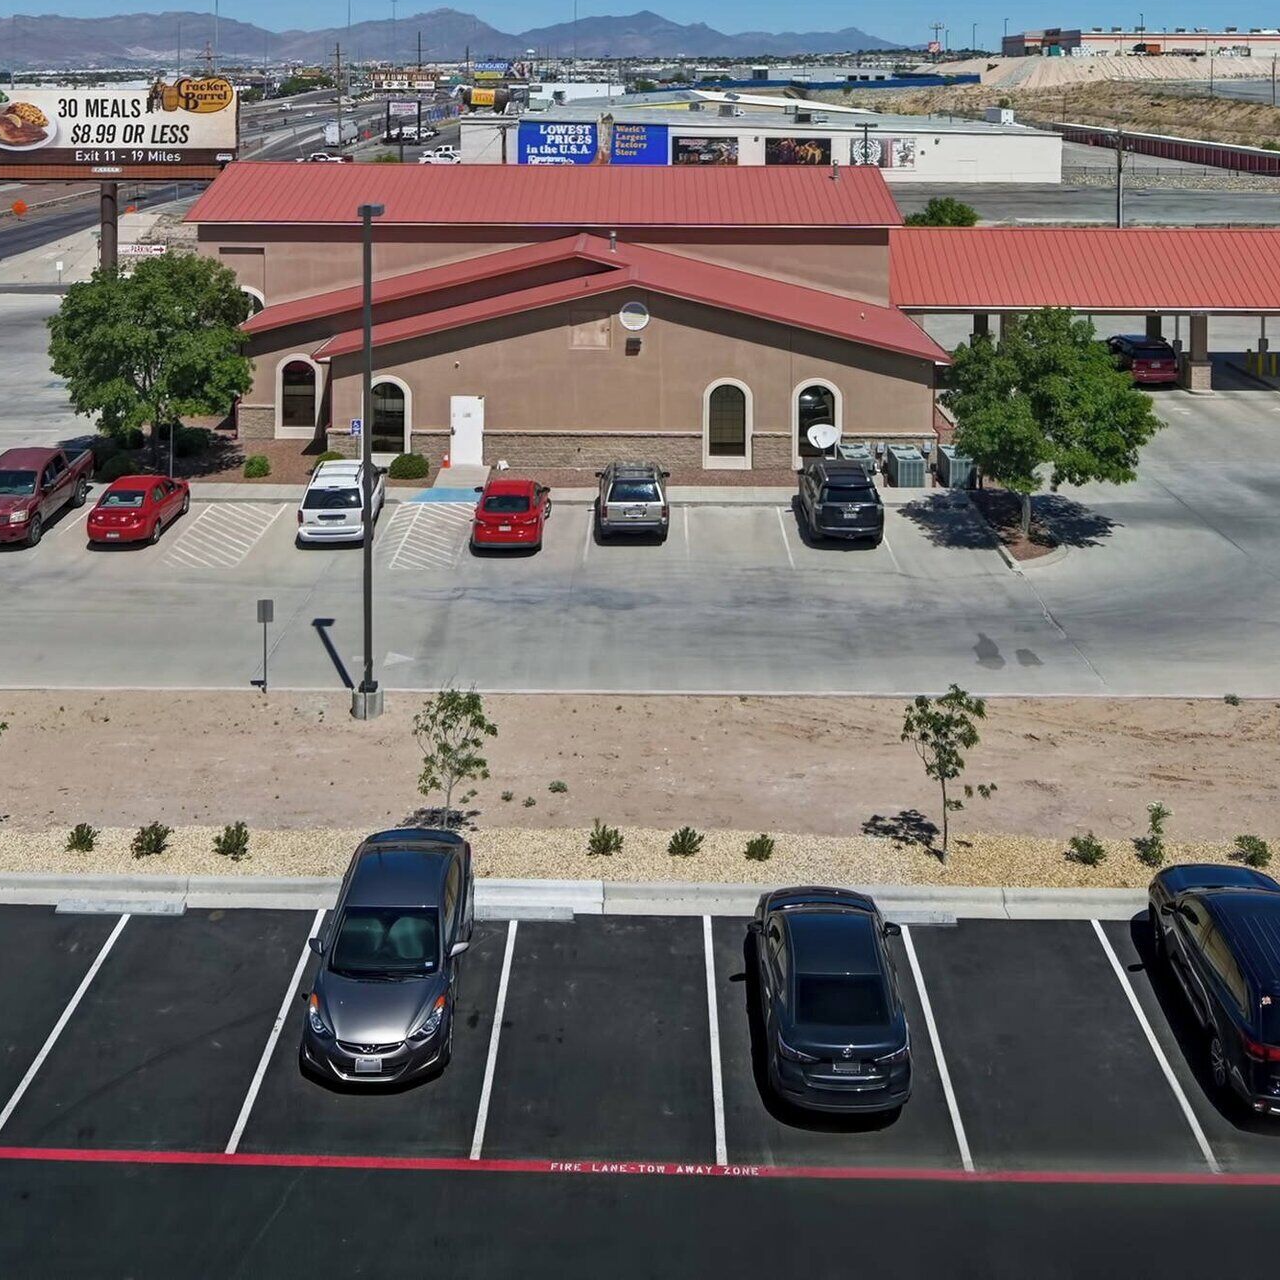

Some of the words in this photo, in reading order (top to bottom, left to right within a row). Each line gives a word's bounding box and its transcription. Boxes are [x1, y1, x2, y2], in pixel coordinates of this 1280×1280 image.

[177, 78, 228, 98] Cracker
[185, 91, 228, 111] Barrel
[58, 98, 78, 118] 30
[85, 98, 141, 118] MEALS
[70, 124, 117, 145] $8.99
[122, 124, 145, 144] OR
[151, 124, 190, 144] LESS
[539, 125, 592, 135] LOWEST
[615, 125, 647, 133] World's
[546, 135, 592, 145] PRICES
[615, 133, 647, 142] Largest
[526, 144, 539, 154] in
[539, 144, 558, 154] the
[559, 144, 592, 154] U.S.A.
[615, 142, 648, 150] Factory
[75, 150, 100, 162] Exit
[104, 150, 116, 162] 11
[131, 150, 143, 162] 19
[148, 150, 181, 162] Miles
[550, 1162, 581, 1171] FIRE
[676, 1166, 712, 1174] AWAY
[723, 1166, 759, 1176] ZONE
